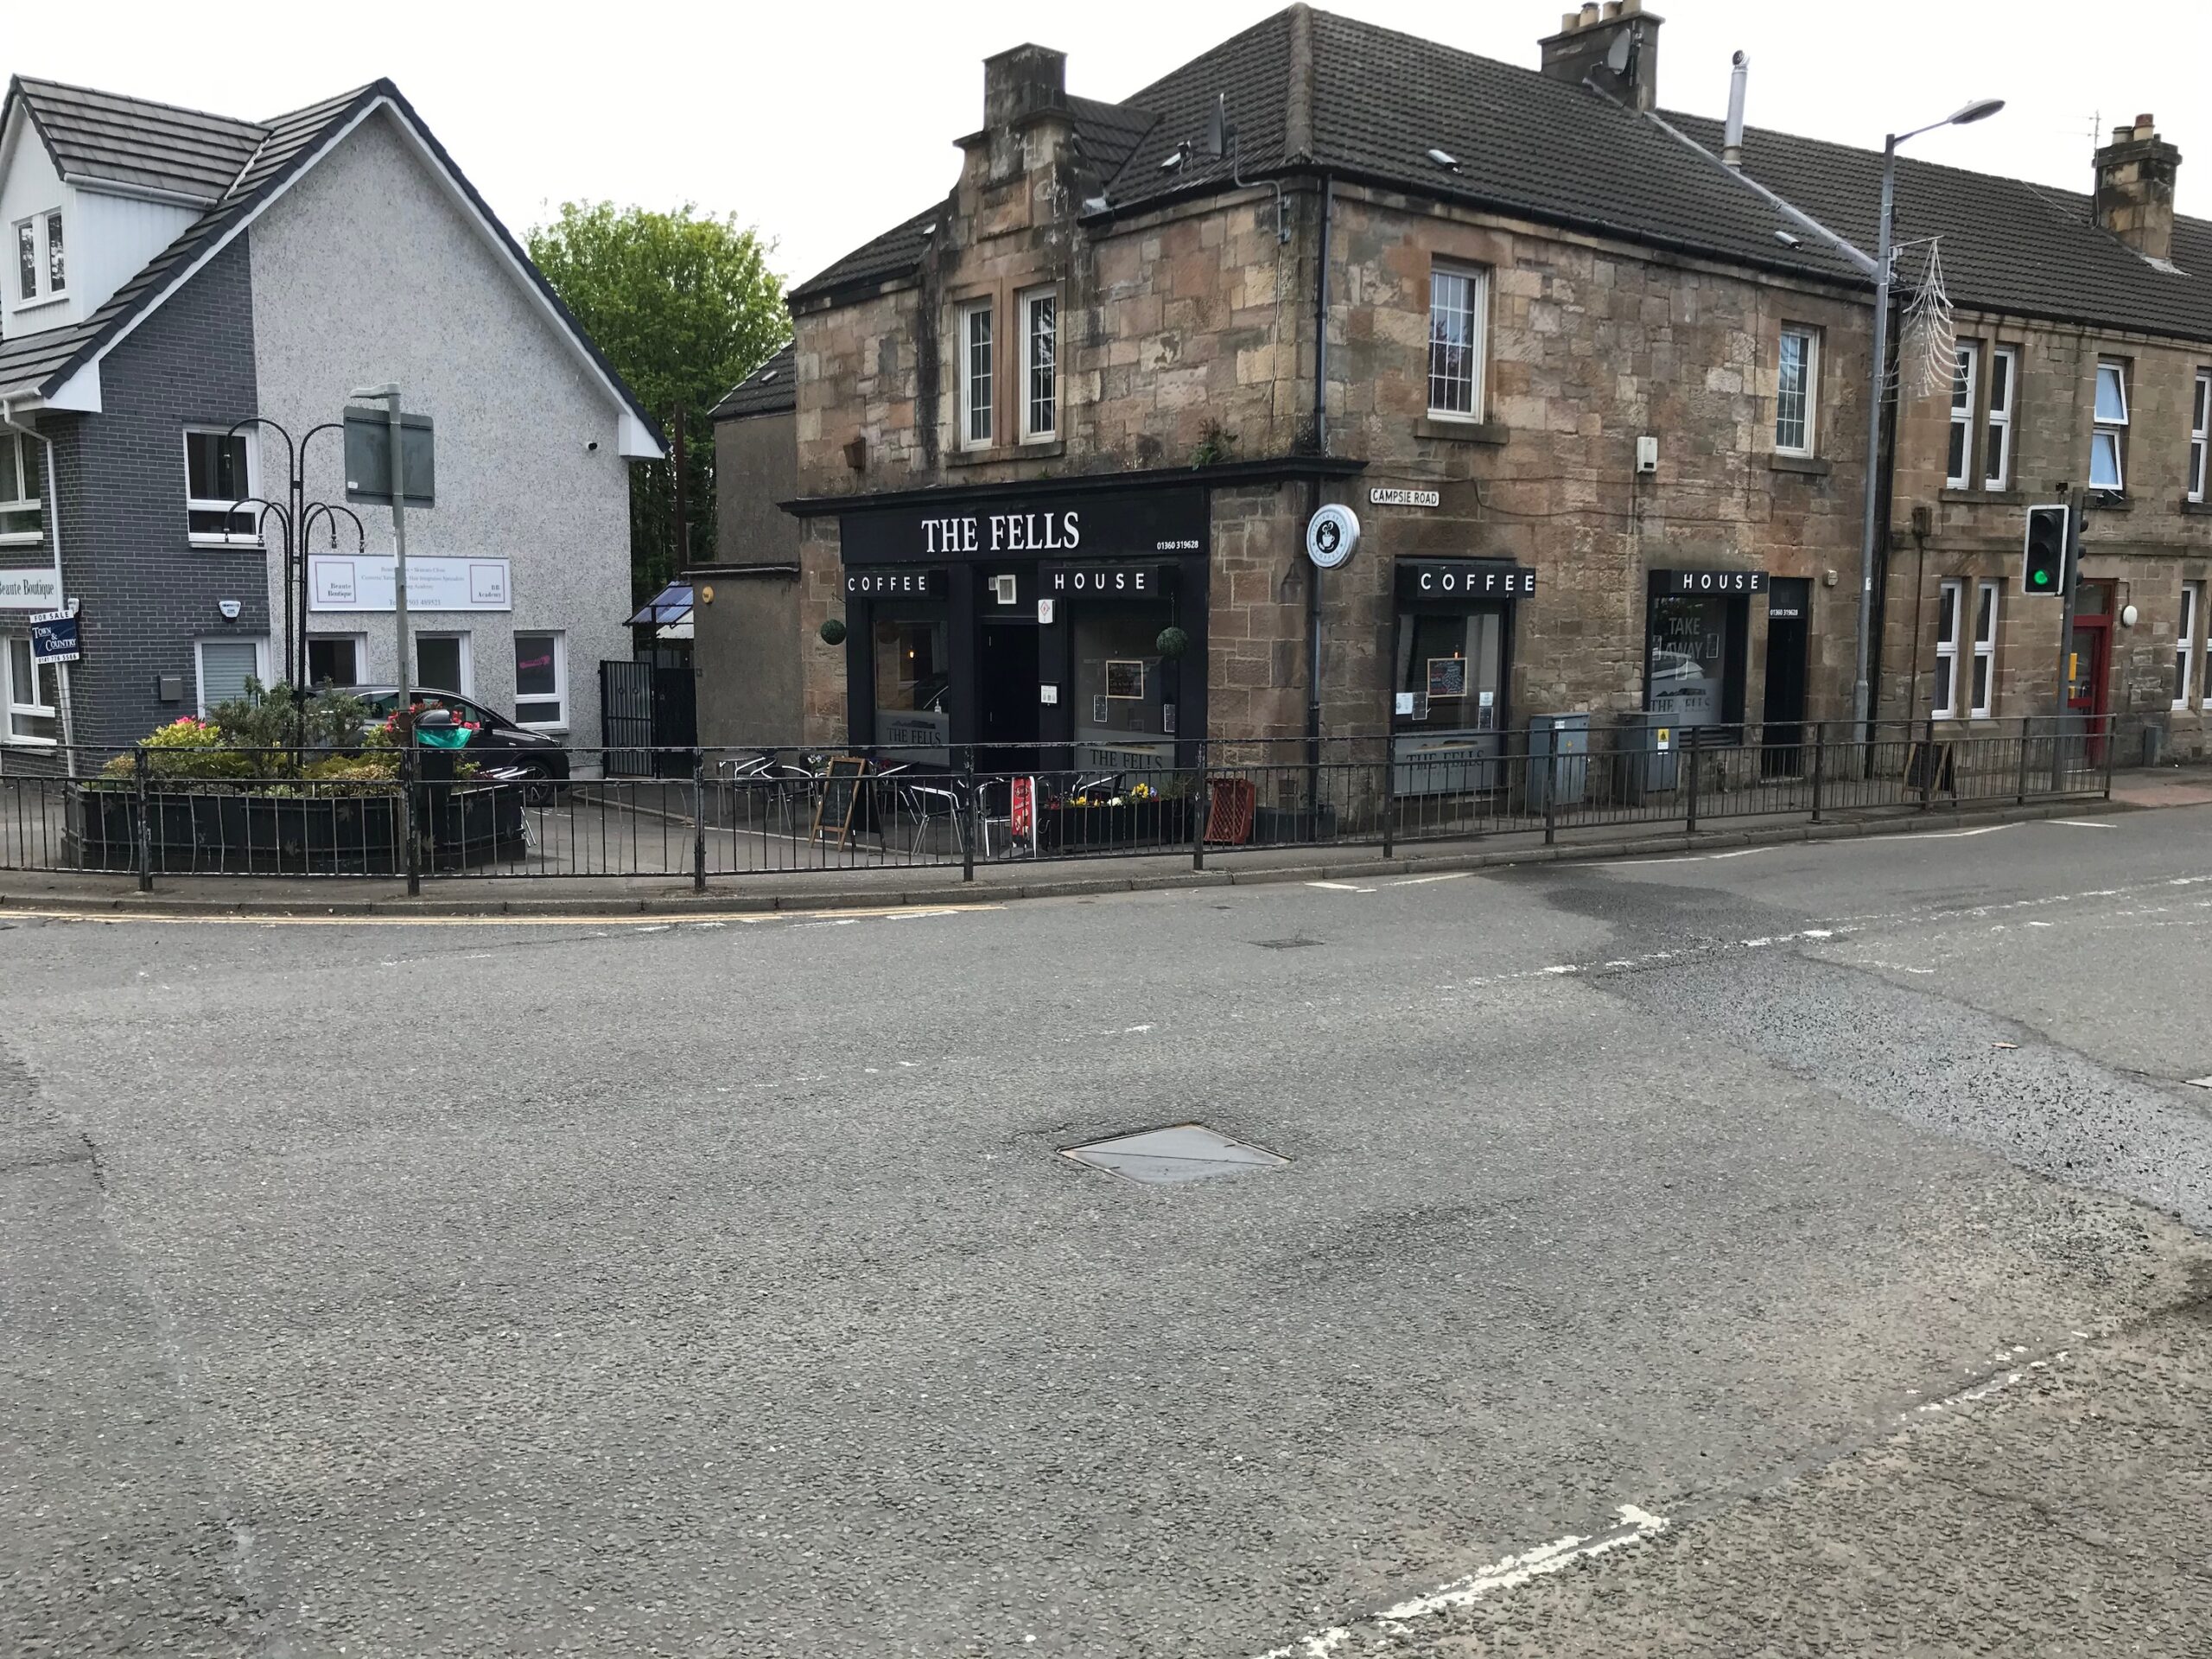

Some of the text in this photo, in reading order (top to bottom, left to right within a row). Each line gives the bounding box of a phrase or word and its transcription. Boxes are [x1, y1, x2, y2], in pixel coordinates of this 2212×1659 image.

[1373, 490, 1437, 504] CAMPSIE ROAD
[921, 512, 1080, 552] THE FELLS
[1157, 540, 1198, 550] 01360 319628
[1315, 550, 1340, 560] COFFEE
[848, 576, 925, 591] COFFEE
[1055, 573, 1145, 589] HOUSE
[1421, 573, 1534, 591] COFFEE
[1683, 574, 1758, 589] HOUSE
[23, 579, 54, 600] Boutique
[50, 611, 69, 620] SALE
[1669, 617, 1700, 636] TAKE
[1663, 641, 1704, 659] AWAY
[887, 728, 941, 745] THE FELLS
[1090, 749, 1162, 770] THE FELLS
